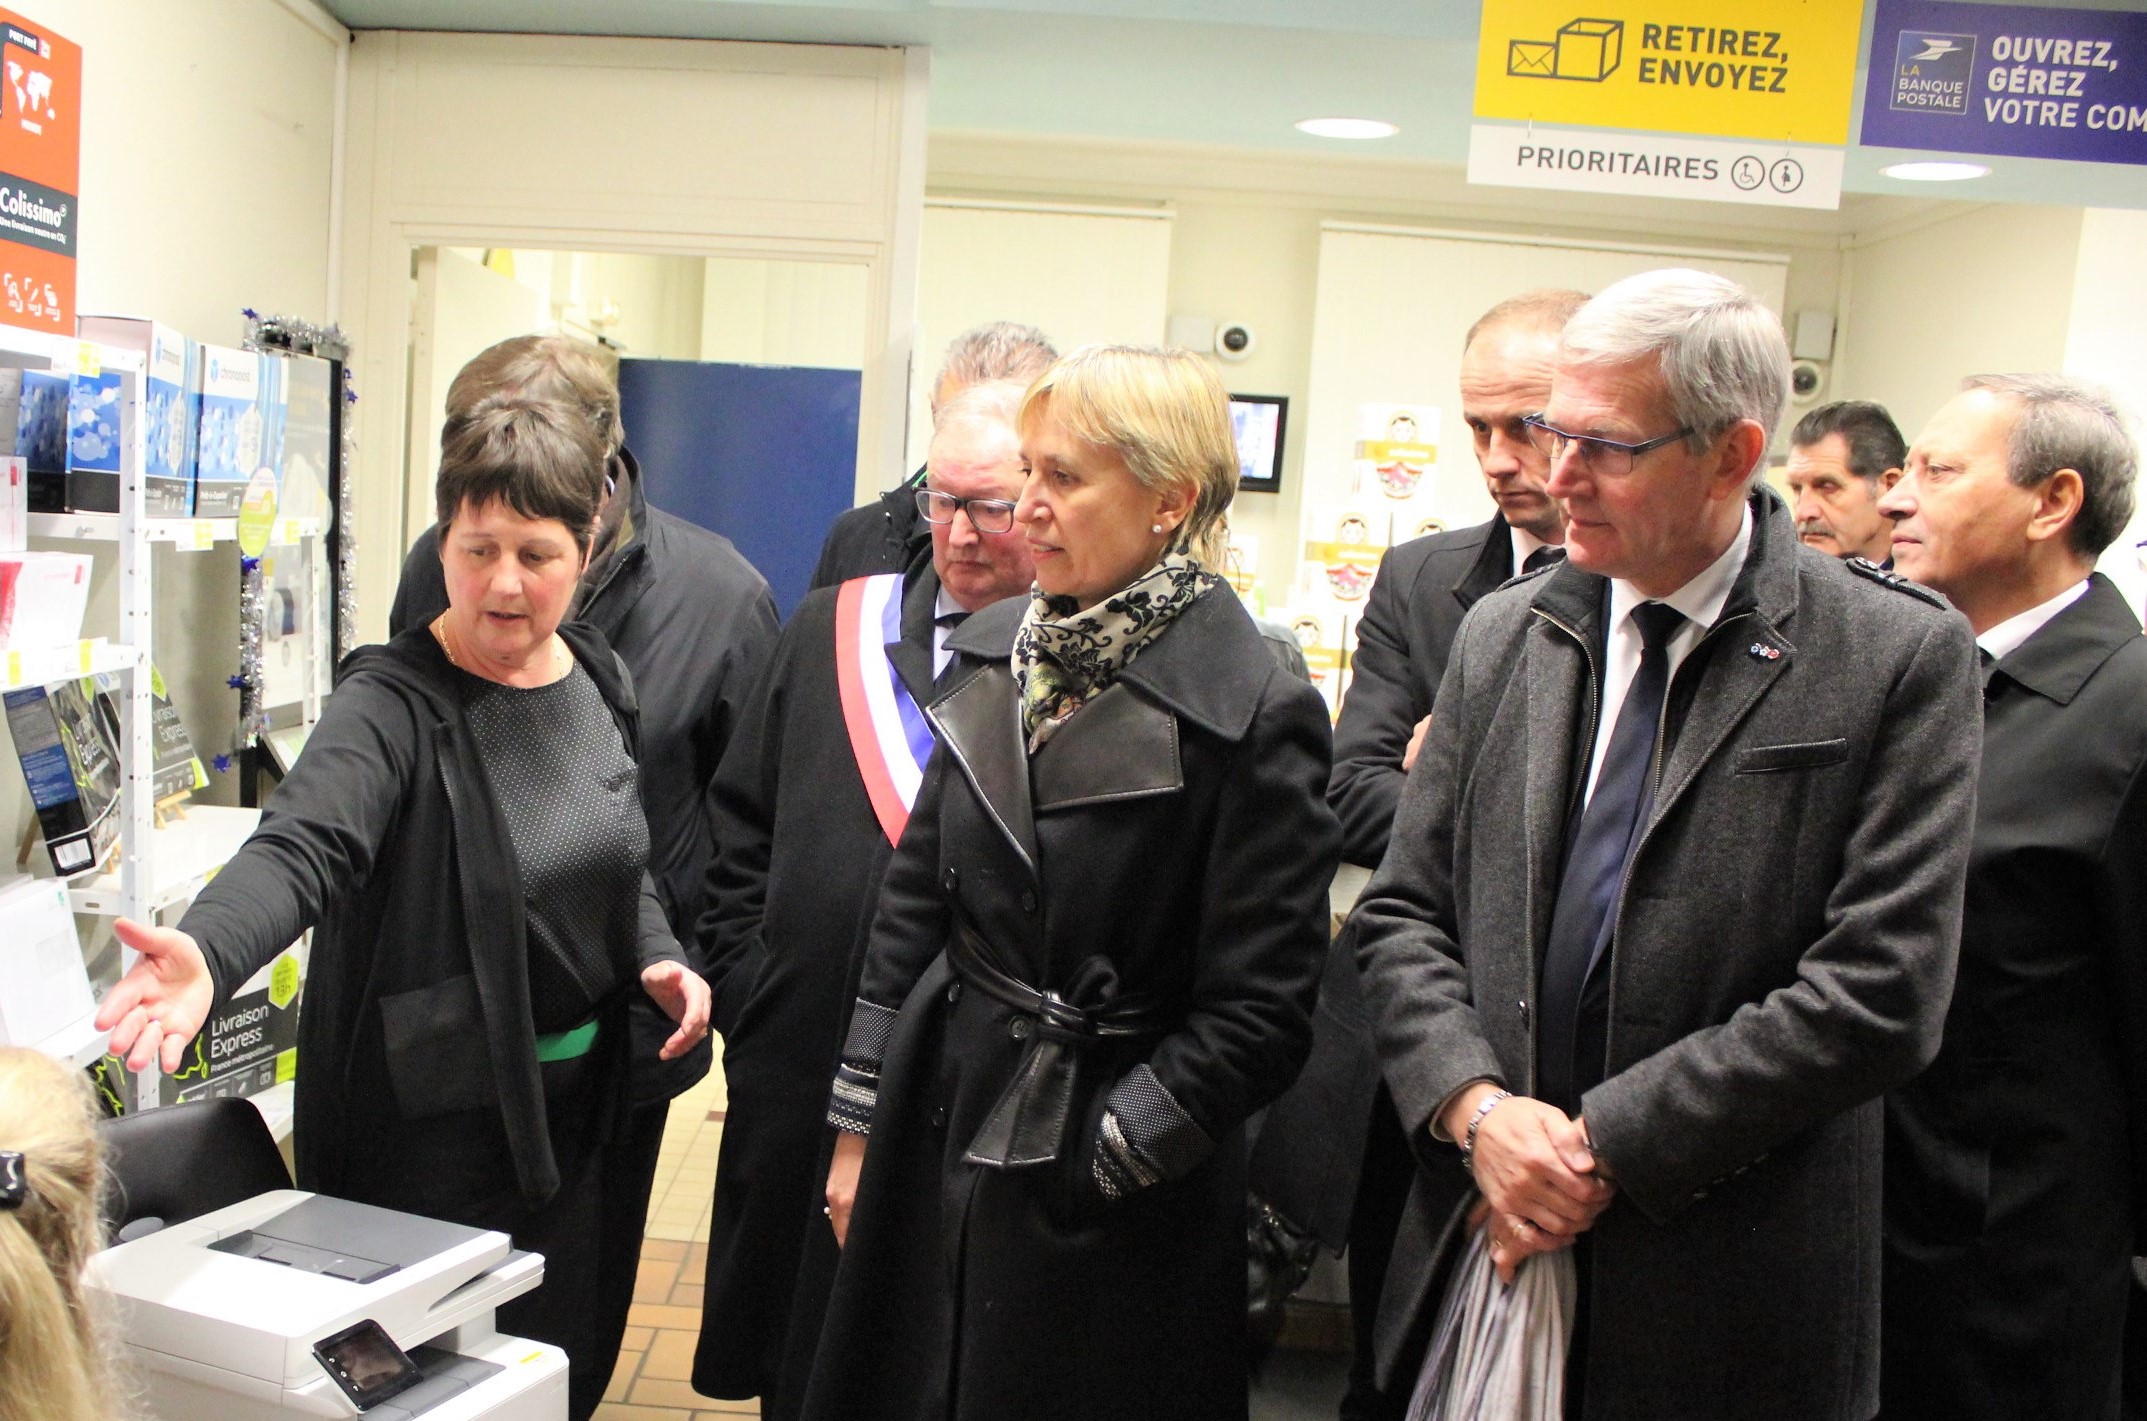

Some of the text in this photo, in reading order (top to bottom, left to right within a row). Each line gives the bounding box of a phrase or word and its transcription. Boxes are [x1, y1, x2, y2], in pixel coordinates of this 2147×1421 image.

[1641, 23, 1788, 64] RETIREZ,
[1992, 36, 2118, 72] OUVREZ,
[1638, 57, 1788, 93] ENVOYEZ
[1901, 64, 1920, 76] LA
[1988, 65, 2086, 96] GÉREZ
[1897, 92, 1961, 108] POSTALE
[1899, 78, 1964, 94] BANQUE
[1984, 97, 2080, 128] VOTRE
[1517, 146, 1719, 180] PRIORITAIRES
[212, 1005, 269, 1037] Livraison
[211, 1027, 262, 1058] Express
